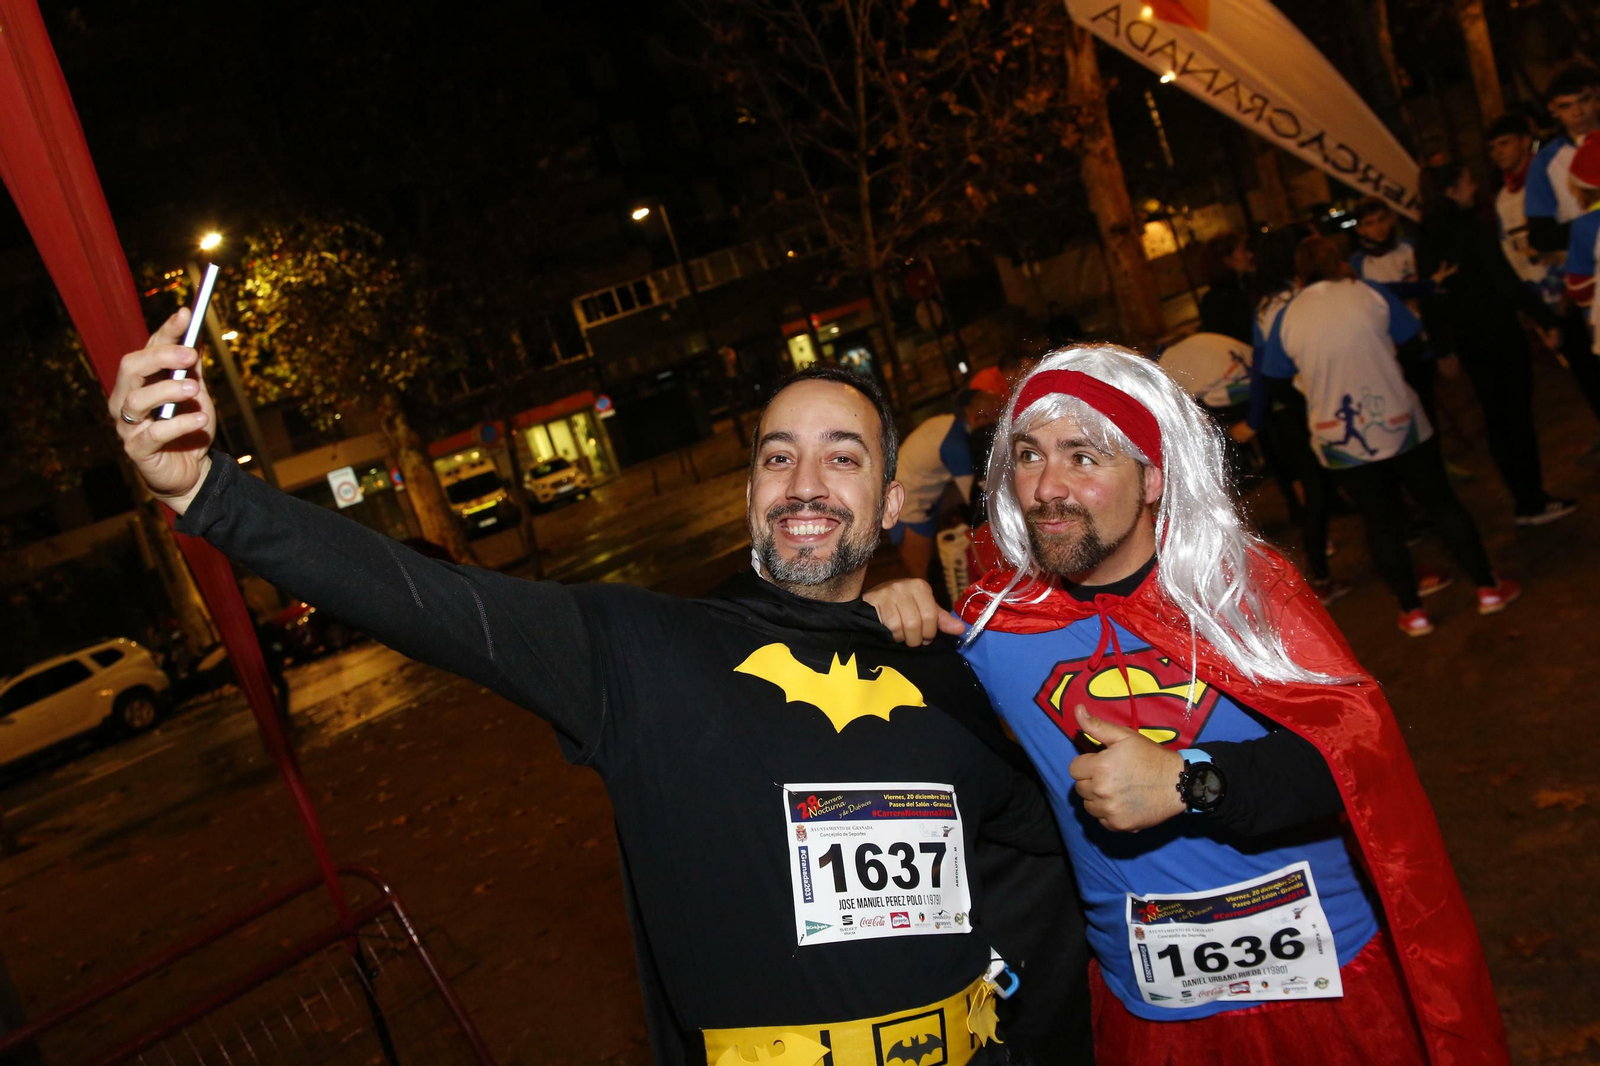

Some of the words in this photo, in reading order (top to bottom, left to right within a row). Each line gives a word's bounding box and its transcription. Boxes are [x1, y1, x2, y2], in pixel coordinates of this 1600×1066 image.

[796, 795, 820, 820] 28
[808, 802, 846, 818] Nocturna
[817, 795, 843, 808] Carrera
[800, 849, 812, 900] #Granada2031
[819, 842, 947, 893] 1637
[839, 898, 856, 910] JOSE
[857, 896, 885, 909] MANUEL
[886, 895, 906, 907] PEREZ
[907, 895, 923, 905] POLO
[1213, 888, 1306, 920] #CarreraNocturna2019
[1226, 894, 1251, 903] Viernes,
[1232, 899, 1251, 908] Paseo
[1261, 892, 1277, 900] Salón
[1280, 882, 1304, 895] Granada
[1147, 908, 1185, 922] Nocturna
[1157, 927, 1305, 978] 1636
[1182, 977, 1207, 988] DANIEL
[1208, 972, 1238, 983] URBANO
